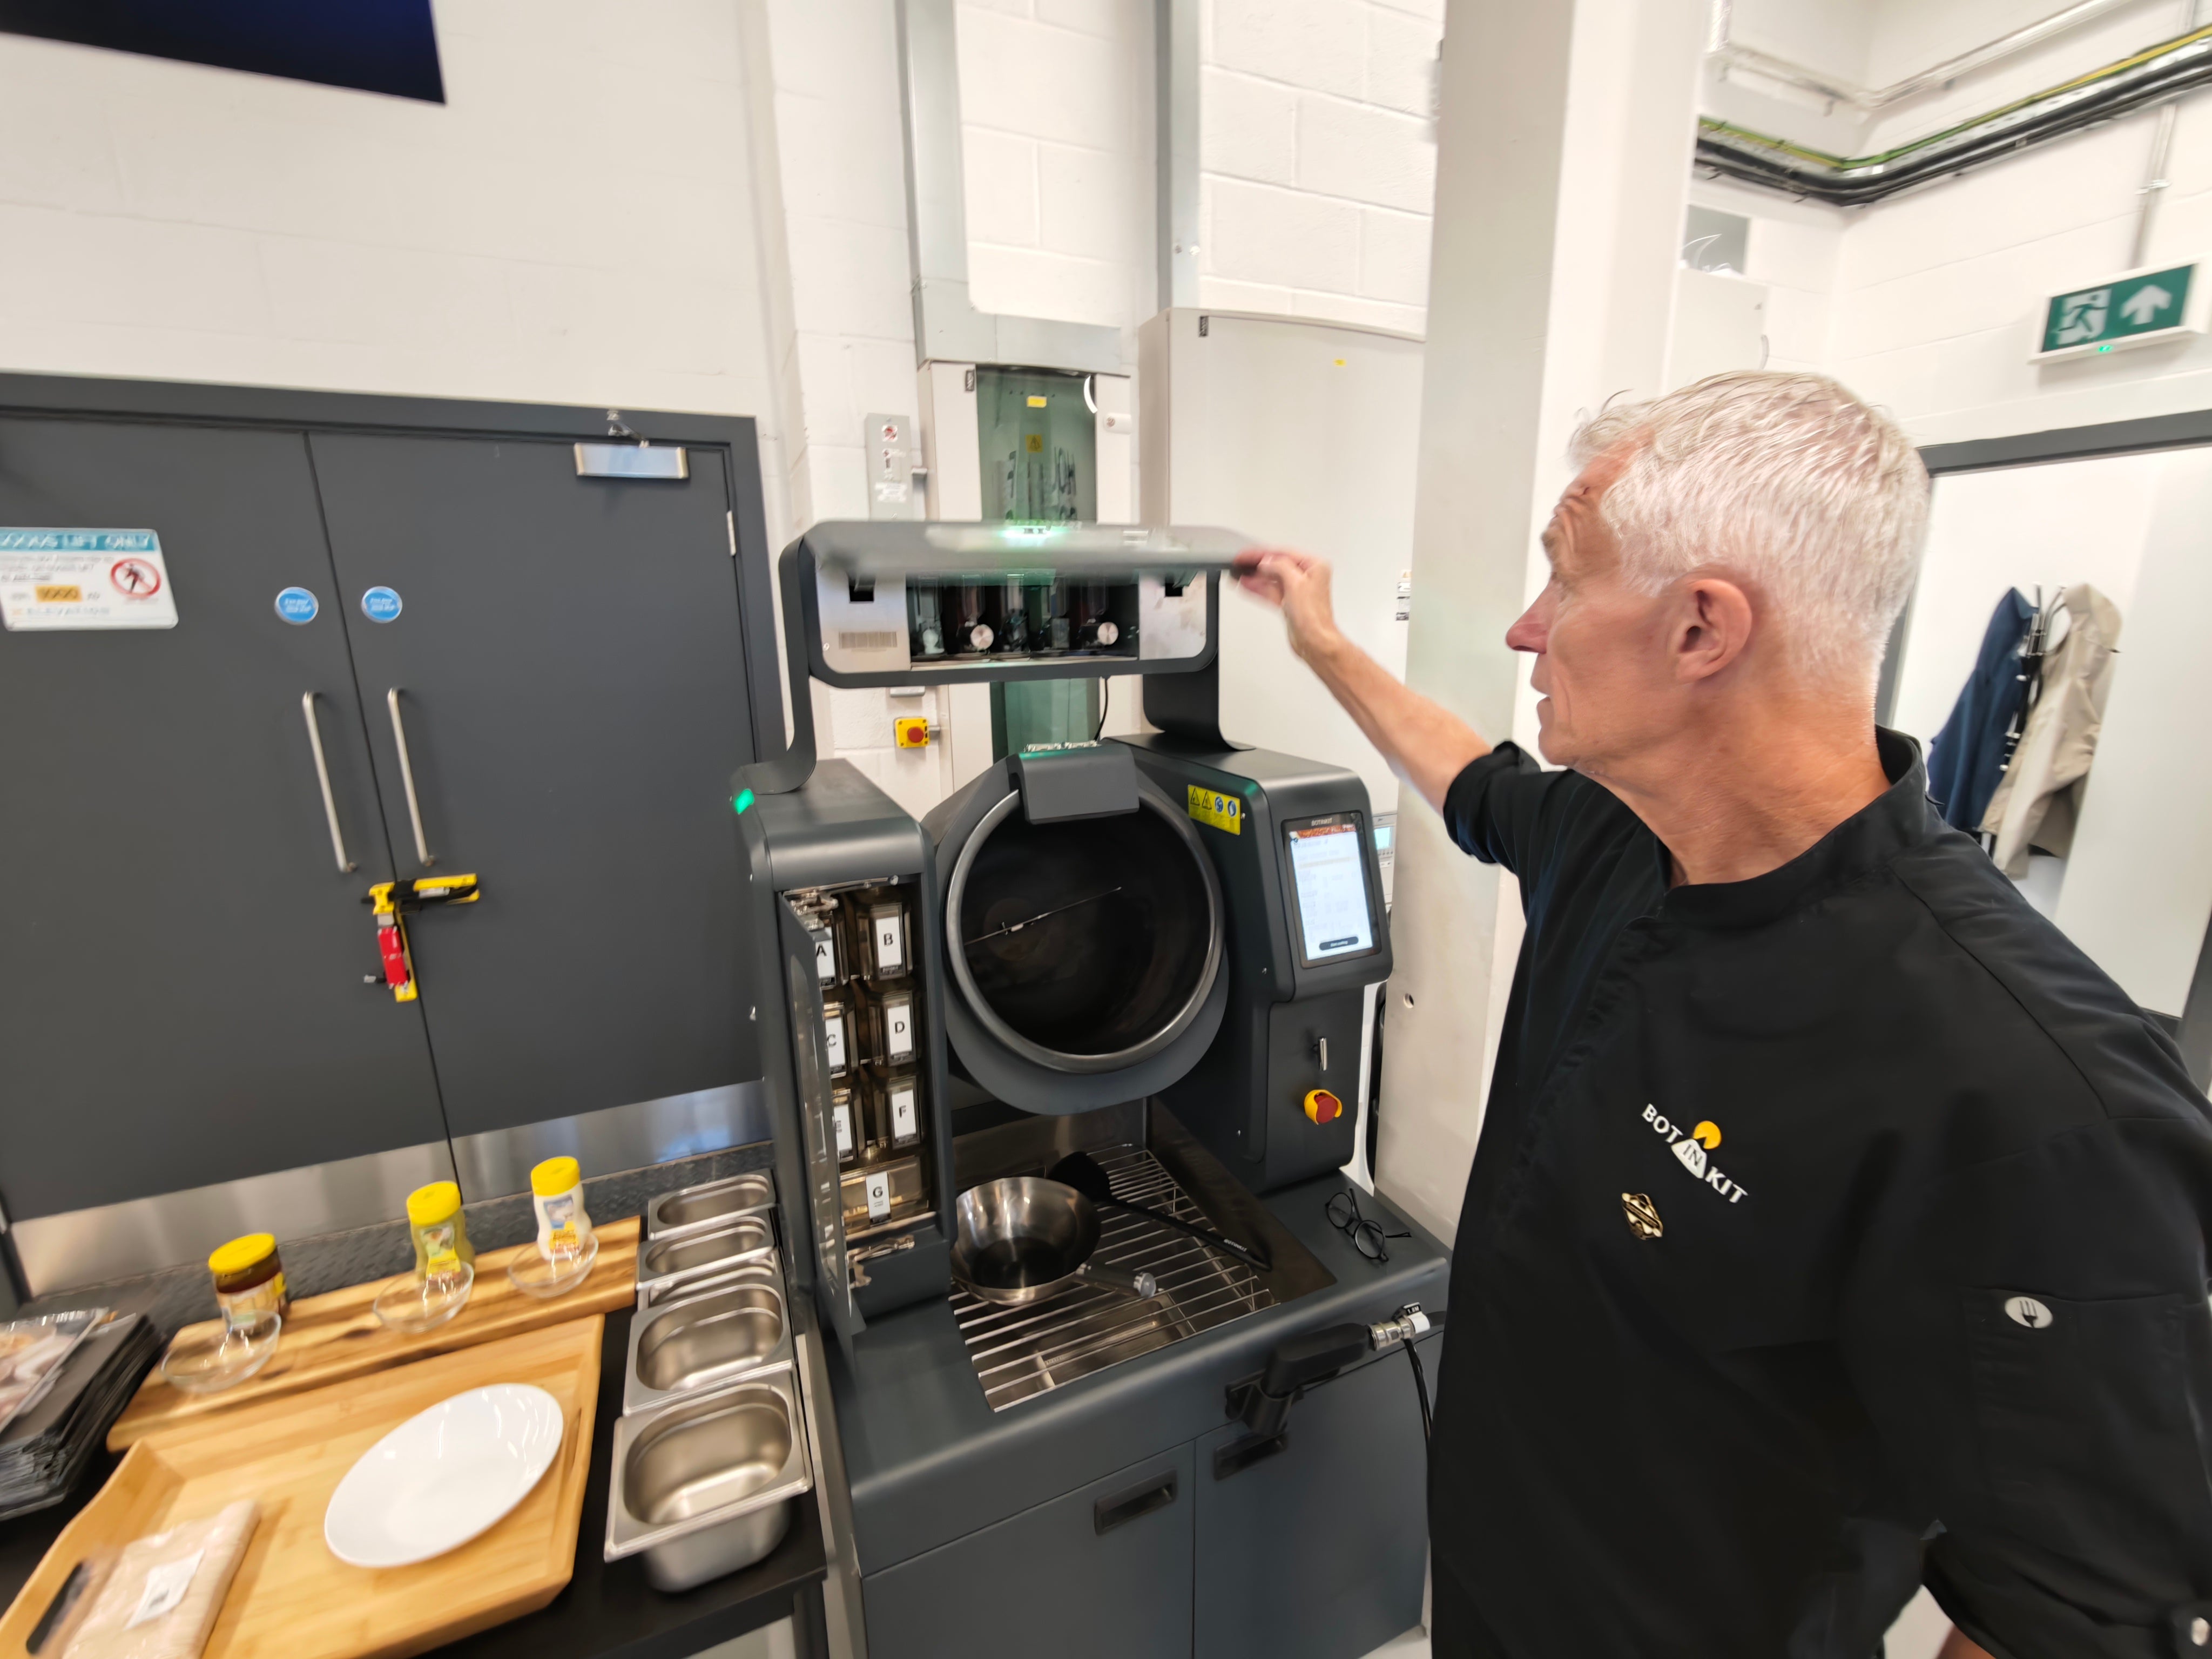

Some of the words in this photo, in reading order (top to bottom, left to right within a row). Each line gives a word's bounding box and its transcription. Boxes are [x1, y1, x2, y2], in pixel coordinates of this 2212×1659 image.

[884, 933, 893, 946] B
[816, 943, 827, 956] A
[895, 1021, 905, 1034] D
[827, 1034, 837, 1047] C
[899, 1105, 906, 1118] F
[873, 1186, 883, 1198] G
